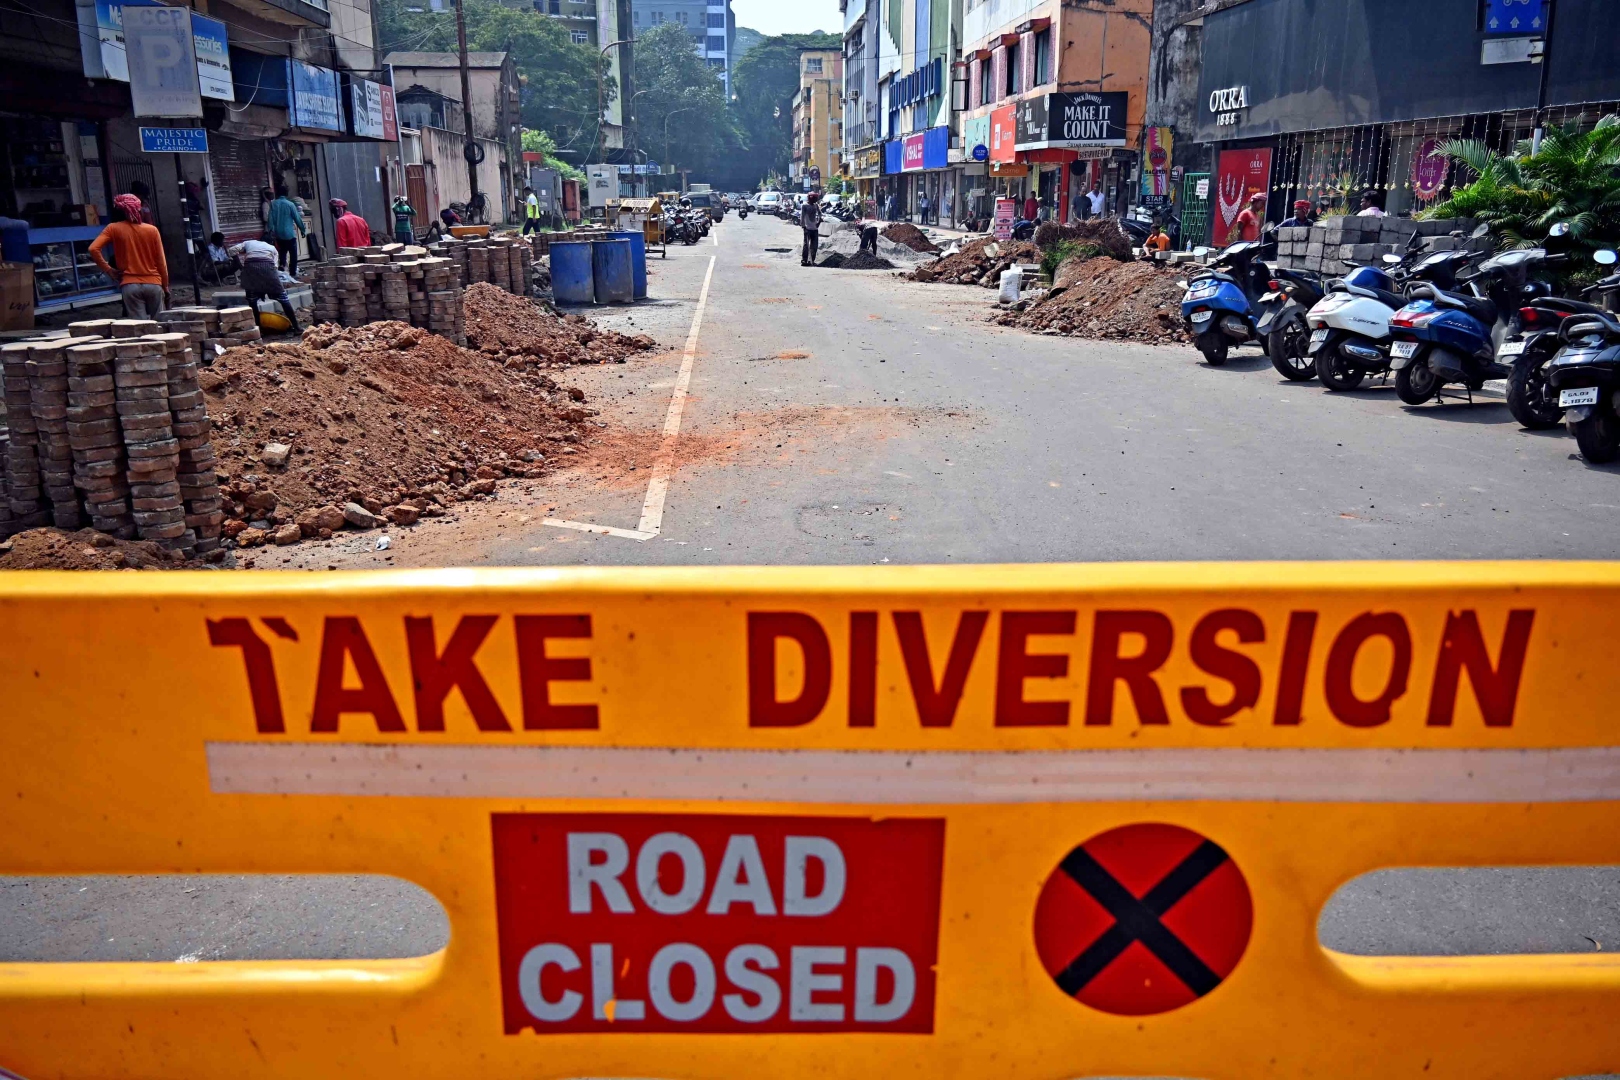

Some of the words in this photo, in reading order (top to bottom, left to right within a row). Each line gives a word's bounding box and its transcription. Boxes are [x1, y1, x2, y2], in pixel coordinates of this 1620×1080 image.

[140, 35, 184, 88] P
[1209, 85, 1249, 113] ORRA
[1064, 106, 1095, 121] MAKE
[1098, 105, 1112, 120] IT
[1216, 112, 1237, 126] 1888
[144, 129, 204, 139] MAJESTIC
[1063, 120, 1111, 139] COUNT
[156, 138, 194, 146] PRIDE
[205, 613, 600, 734] TAKE
[745, 609, 1536, 729] DIVERSION
[566, 832, 847, 917] ROAD
[518, 942, 916, 1023] CLOSED
